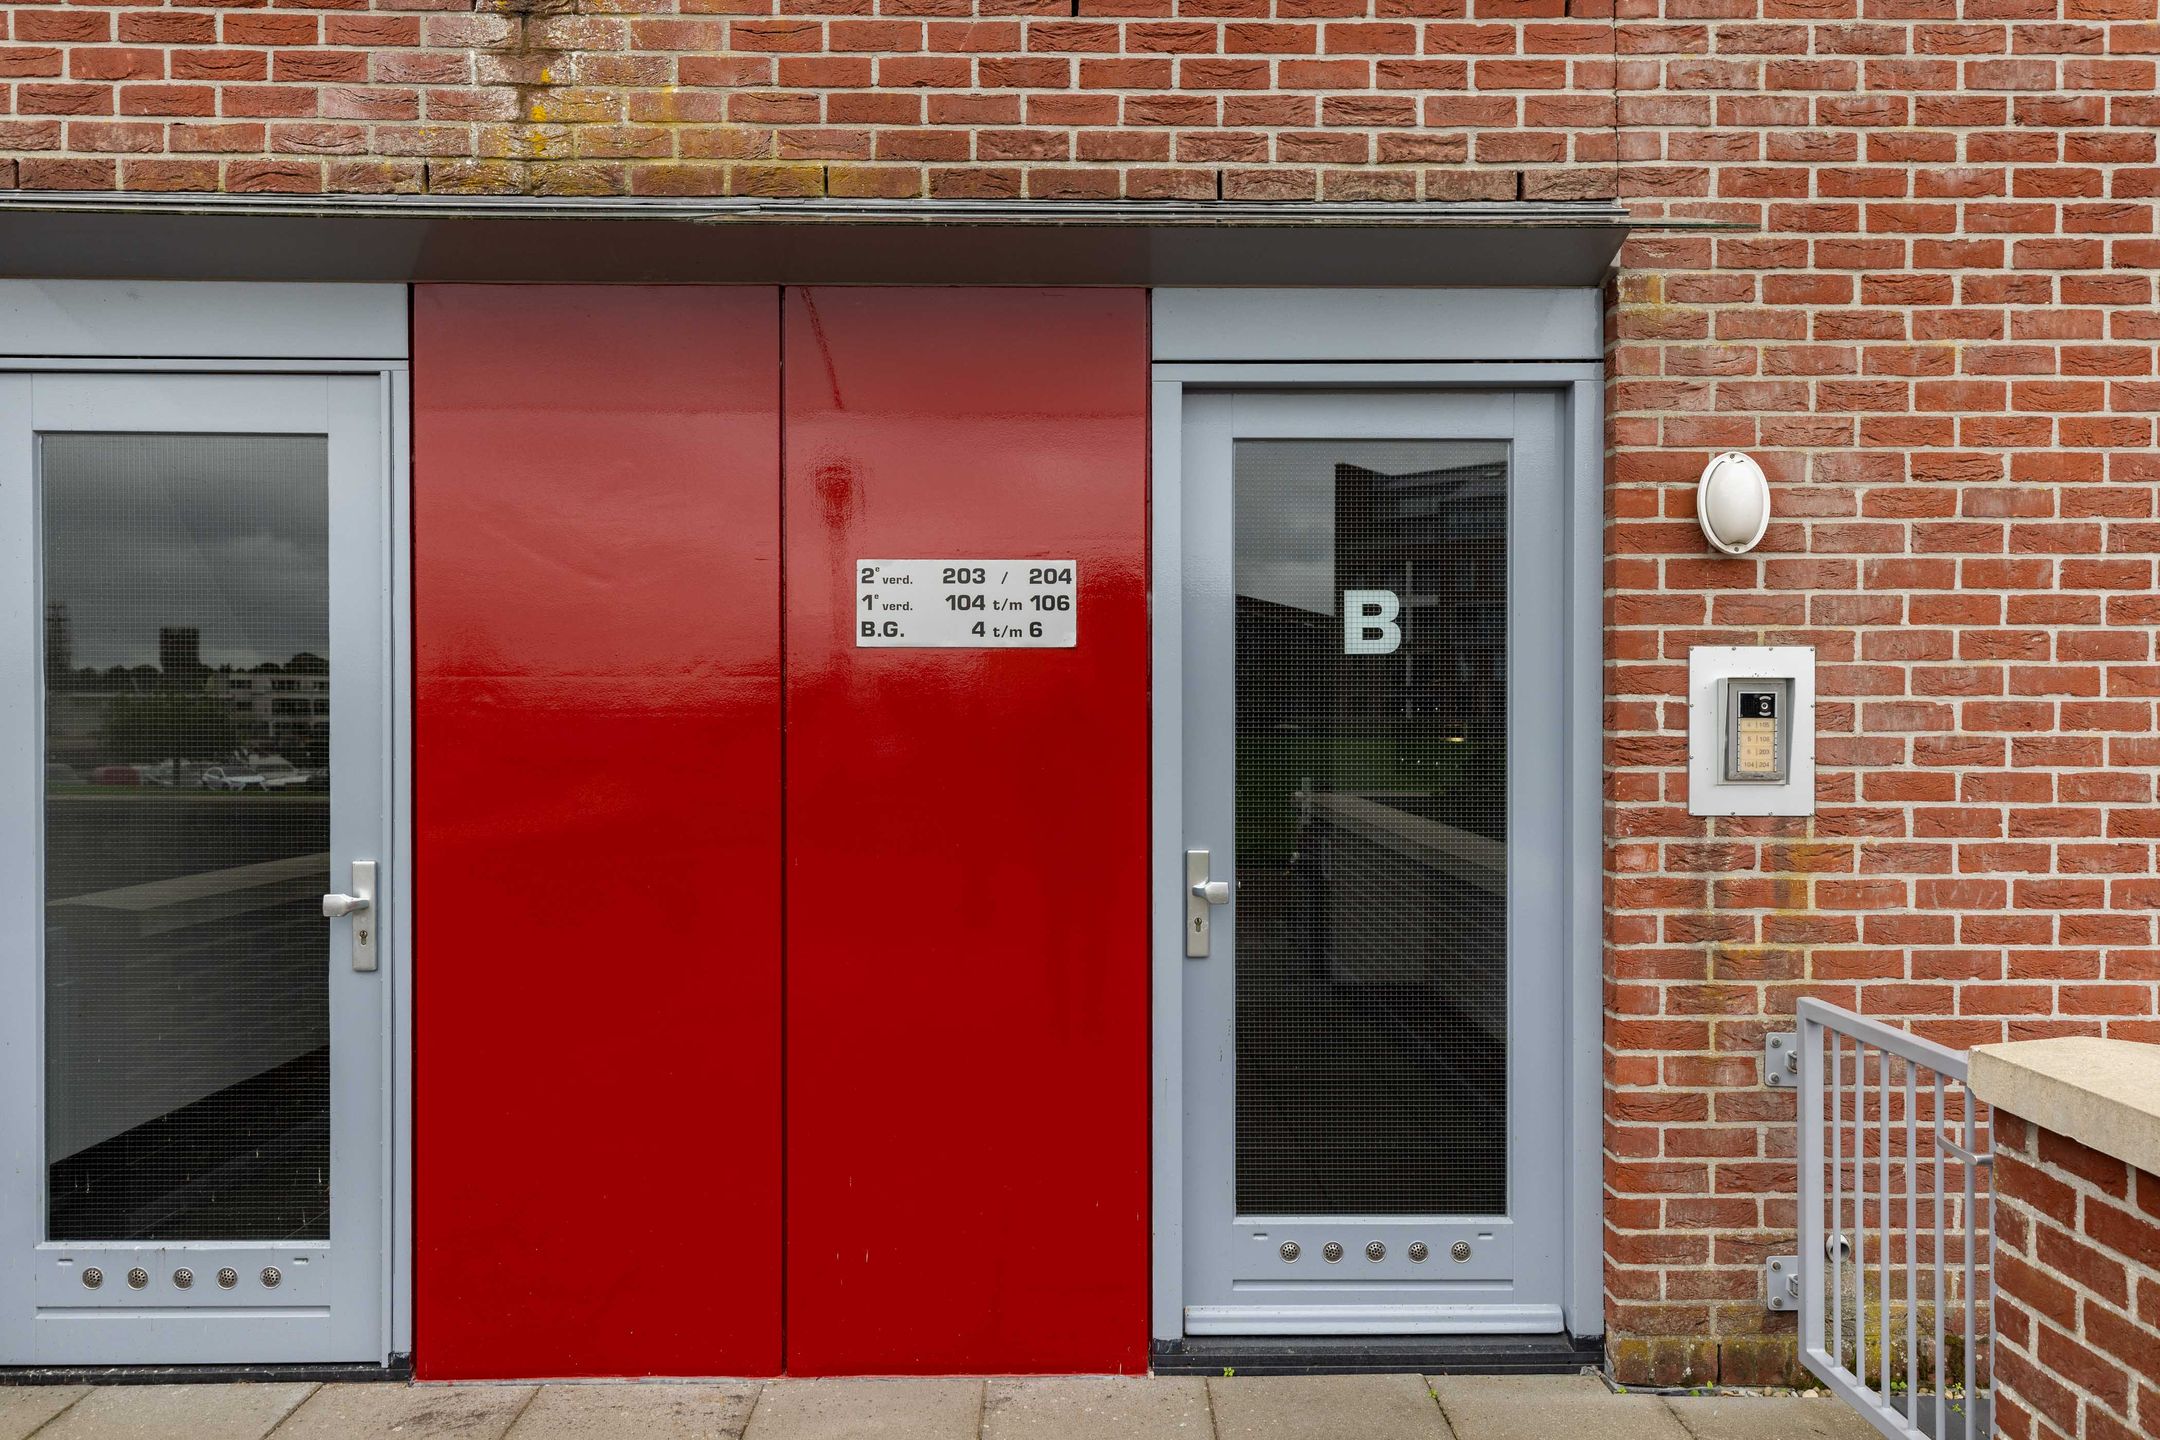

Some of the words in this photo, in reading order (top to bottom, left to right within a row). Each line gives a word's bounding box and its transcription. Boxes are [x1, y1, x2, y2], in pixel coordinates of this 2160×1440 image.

[882, 574, 914, 585] verd.
[942, 567, 986, 585] 203
[1029, 568, 1073, 585] 204
[882, 600, 914, 611] verd.
[944, 594, 986, 611] 104
[993, 598, 1023, 612] t/m
[1030, 594, 1071, 612] 106
[861, 620, 905, 638] B.G.
[971, 621, 986, 638] 4
[993, 624, 1023, 638] t/m
[1029, 621, 1043, 638] 6
[1344, 590, 1401, 654] B
